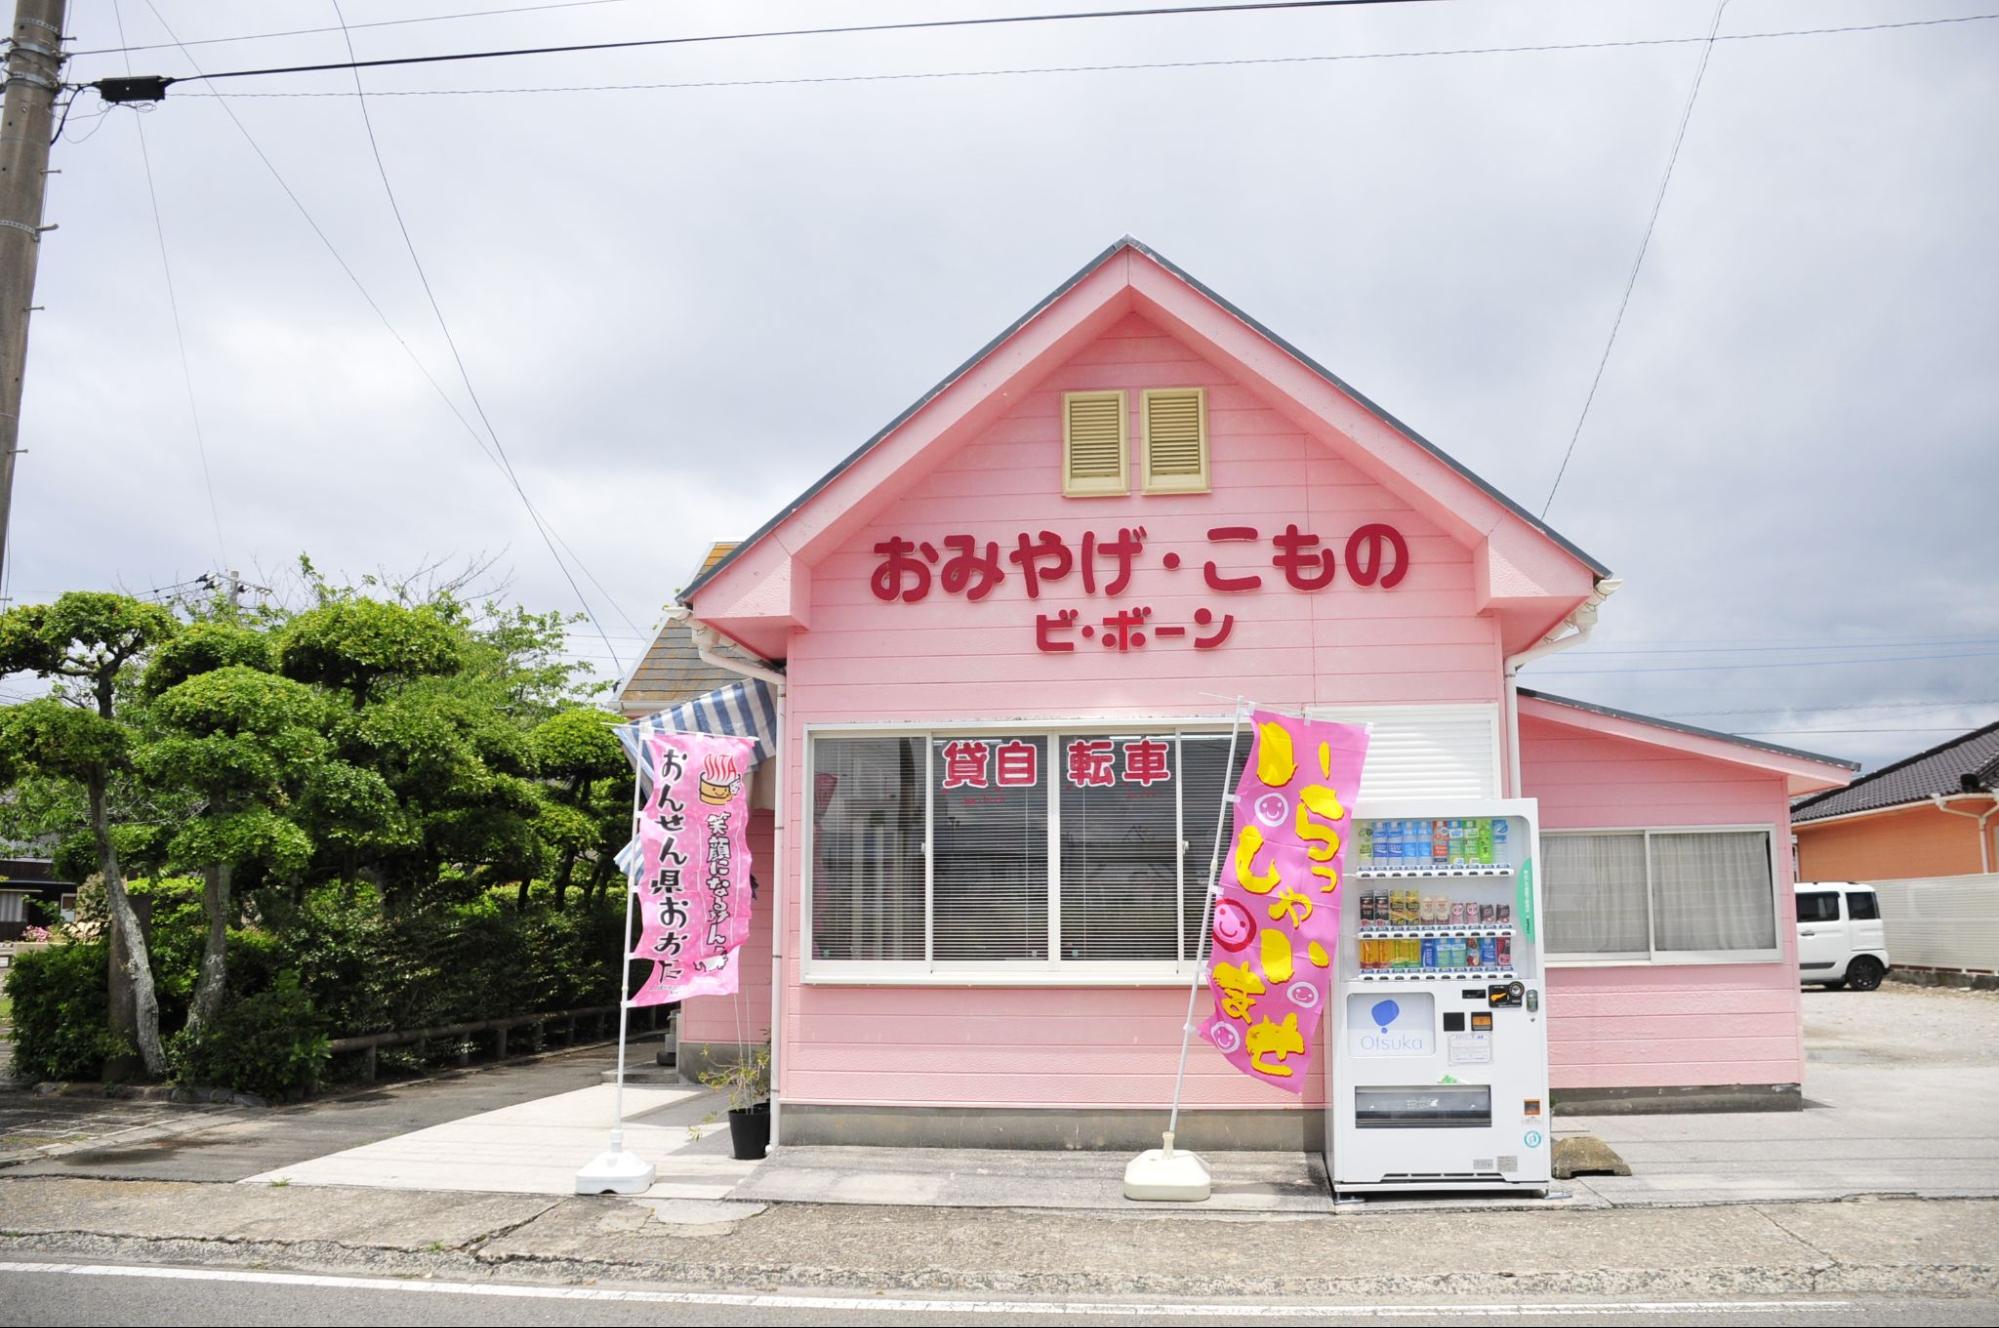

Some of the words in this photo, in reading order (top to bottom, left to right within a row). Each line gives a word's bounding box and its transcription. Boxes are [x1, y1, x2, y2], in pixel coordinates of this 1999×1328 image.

[870, 523, 1409, 602] おみやげ・こもの
[1035, 606, 1234, 654] ビ・ボーン
[651, 748, 688, 983] おんせん県おおた
[1360, 1034, 1423, 1050] Otsuka
